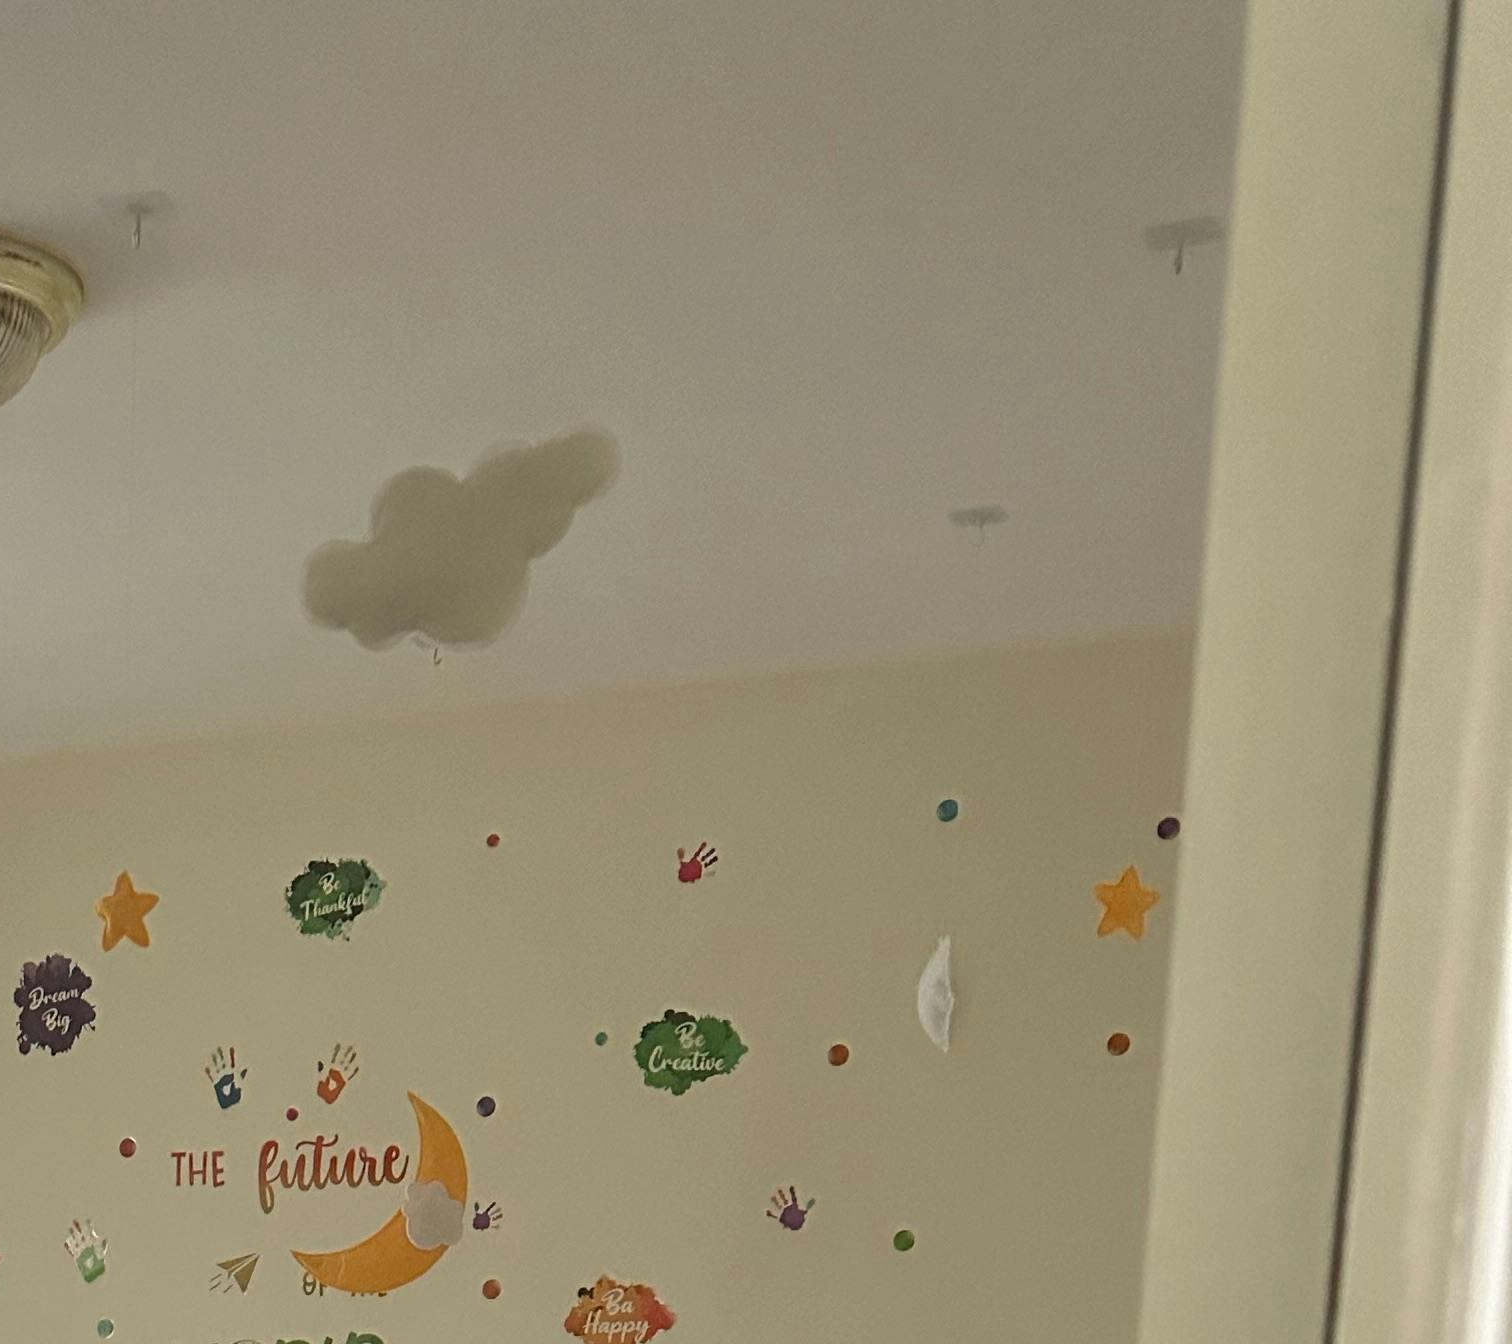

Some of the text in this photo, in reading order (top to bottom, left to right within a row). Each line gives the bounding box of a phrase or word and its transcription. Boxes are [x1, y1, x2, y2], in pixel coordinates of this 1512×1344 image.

[319, 872, 341, 895] Be
[299, 887, 369, 921] Thankful
[28, 986, 80, 1010] Dream
[42, 1007, 72, 1035] Big
[675, 1021, 707, 1049] Be
[648, 1045, 726, 1073] Creative
[171, 1134, 410, 1214] THE future
[583, 1309, 651, 1344] Happy
